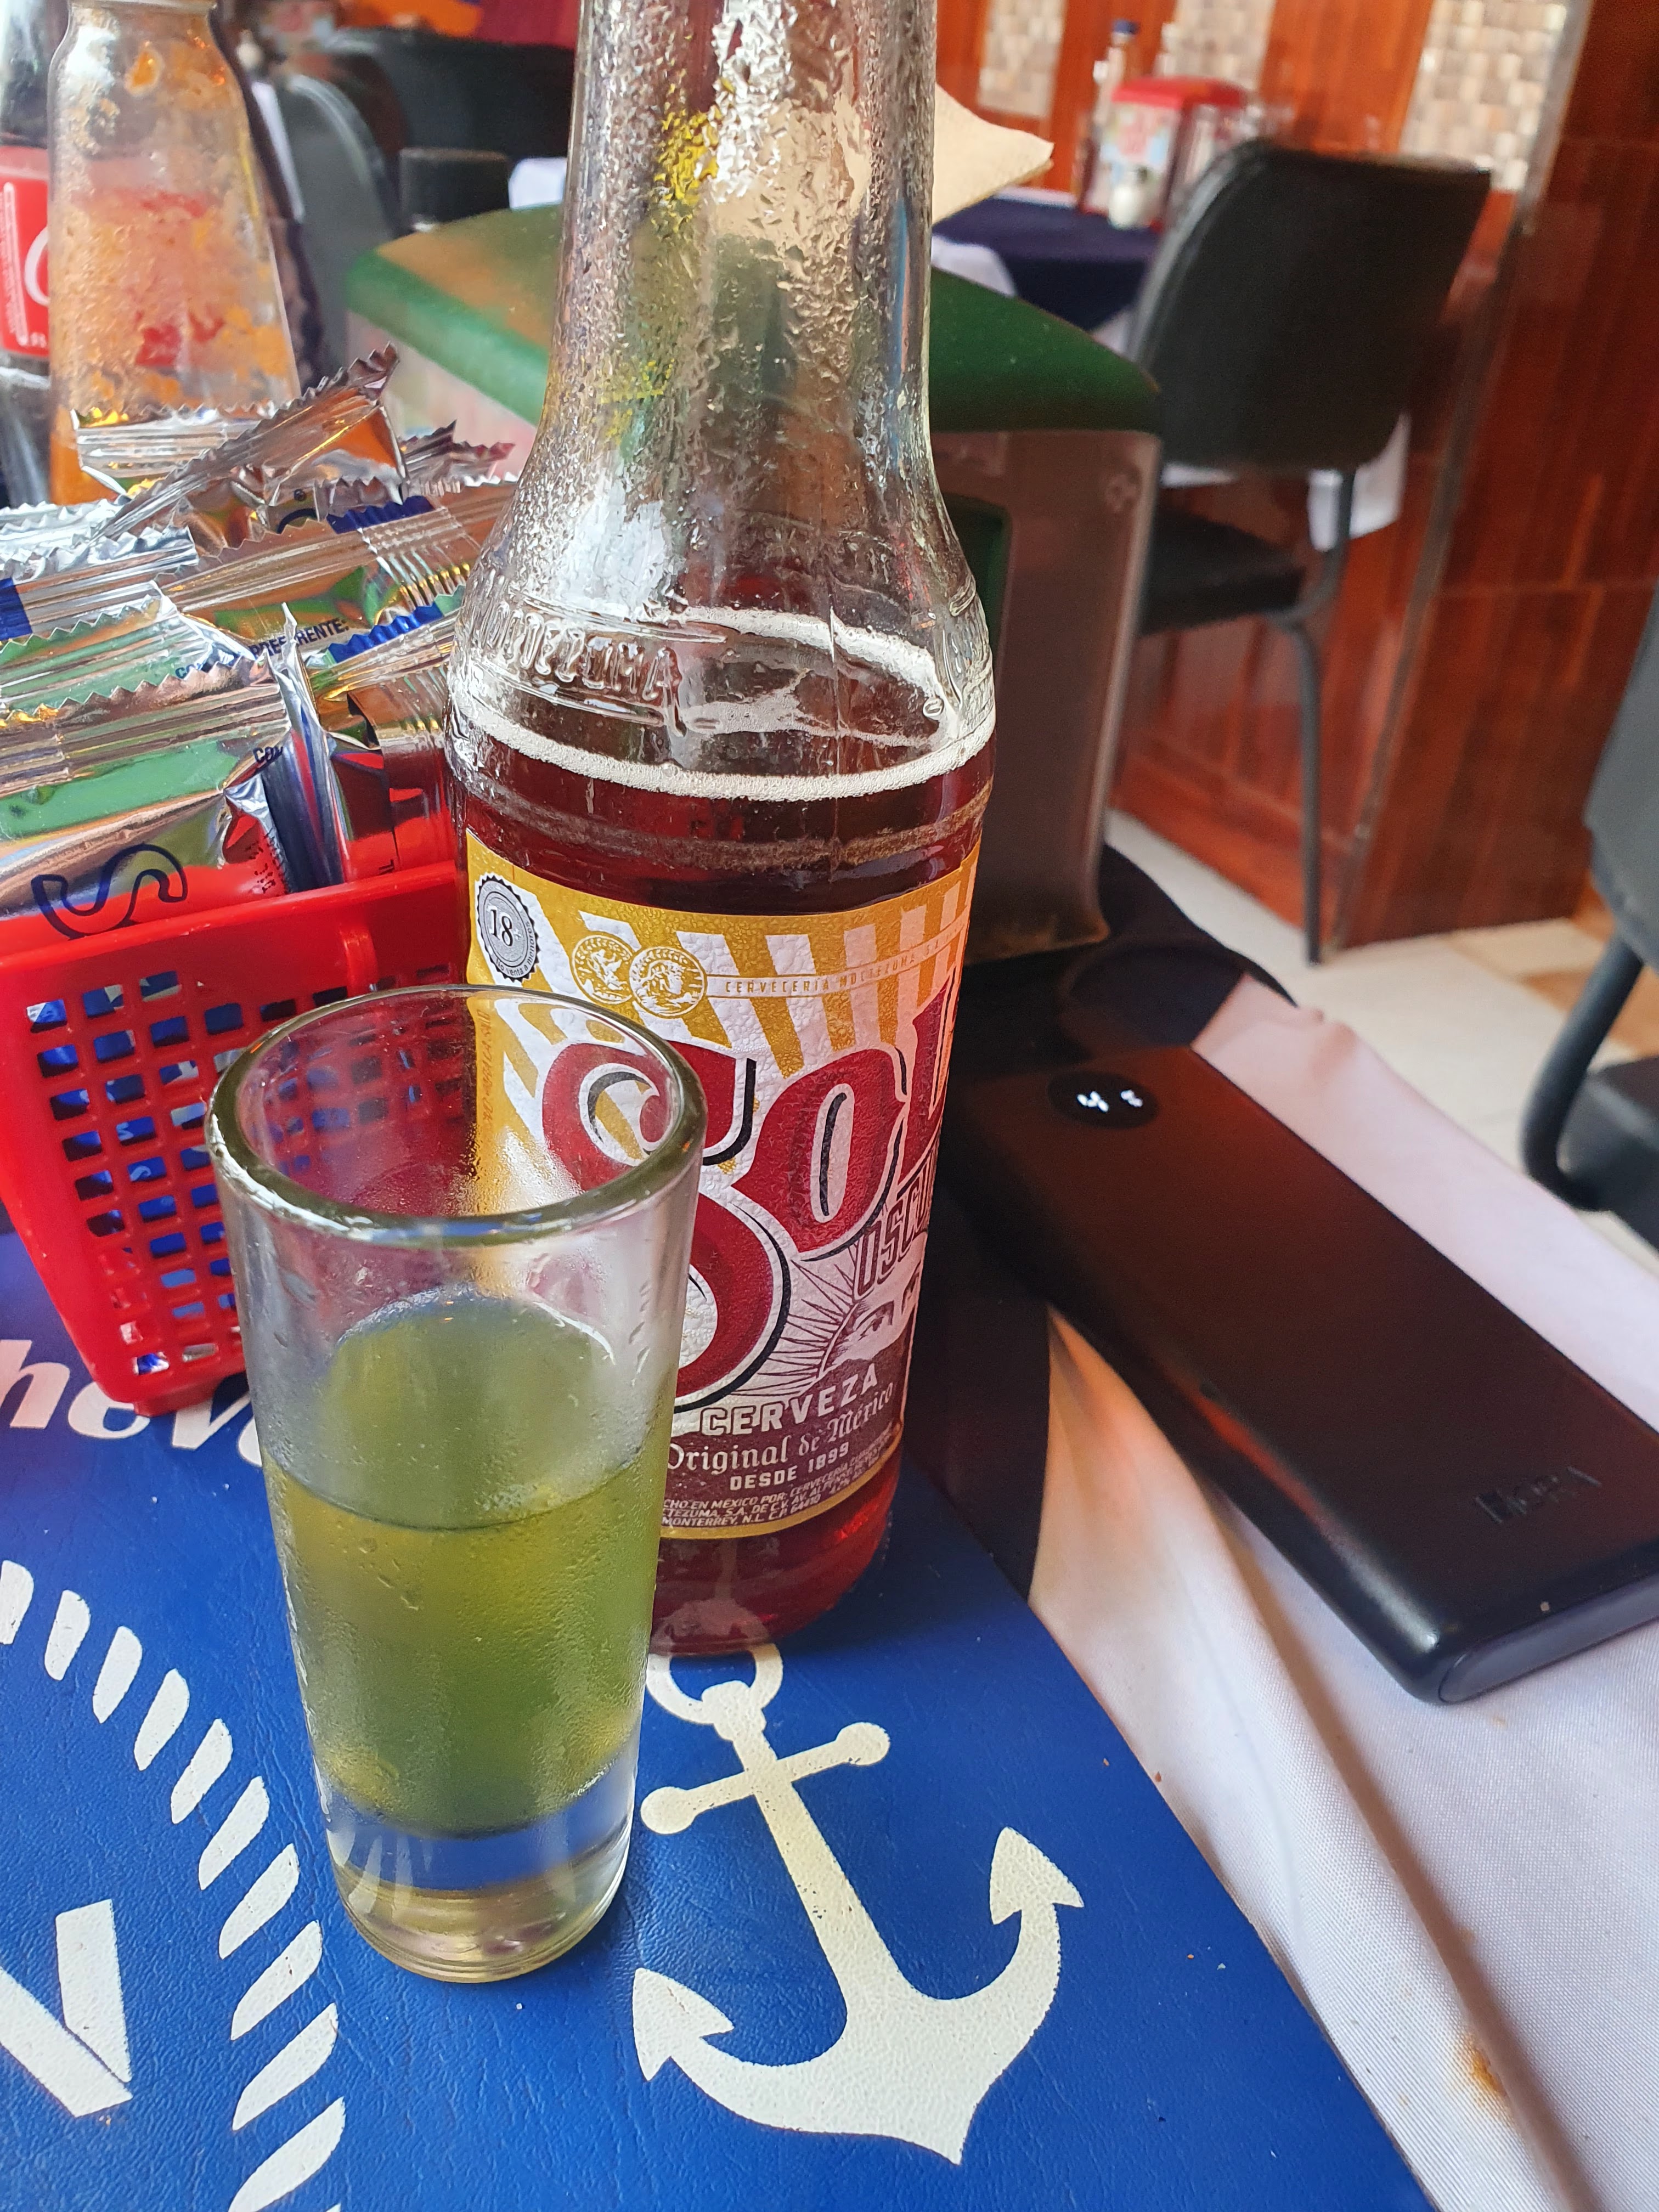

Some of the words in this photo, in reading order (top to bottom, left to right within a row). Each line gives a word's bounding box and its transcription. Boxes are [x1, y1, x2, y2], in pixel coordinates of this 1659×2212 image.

[495, 957, 504, 972] No
[506, 967, 524, 977] venta
[524, 963, 528, 972] a
[526, 921, 535, 966] menores
[700, 1363, 877, 1436] CERVEZA
[668, 1434, 792, 1476] Original
[798, 1432, 821, 1457] de
[730, 1465, 798, 1491] DESDE
[807, 1441, 850, 1474] 1899
[690, 1500, 708, 1509] EN
[710, 1496, 759, 1509] MÉXICO
[760, 1492, 788, 1504] POR:
[751, 1504, 768, 1514] DE
